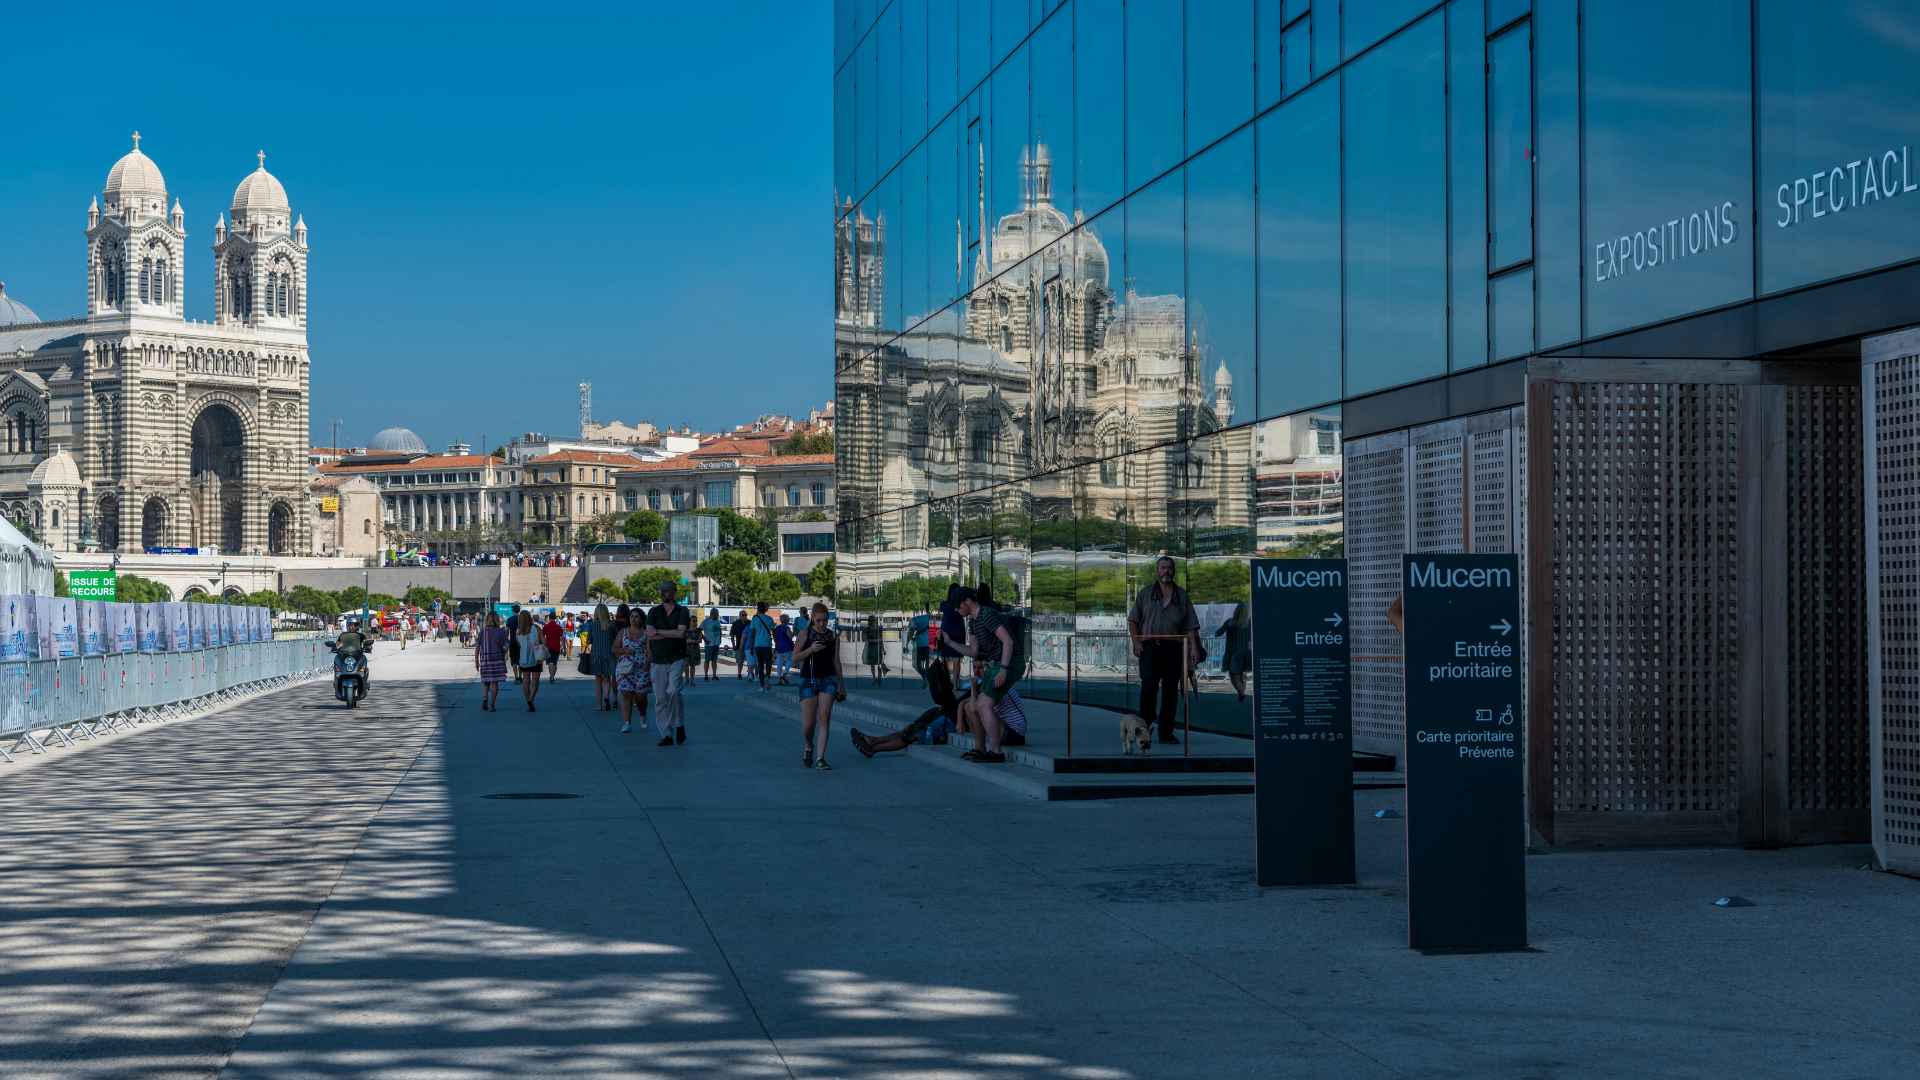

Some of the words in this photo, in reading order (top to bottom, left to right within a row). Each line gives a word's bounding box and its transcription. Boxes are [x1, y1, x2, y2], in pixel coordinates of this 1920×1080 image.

[1776, 145, 1918, 228] SPECTACL
[1595, 201, 1736, 282] EXPOSITIONS
[71, 578, 98, 586] ISSUE
[103, 578, 115, 586] DE
[1257, 566, 1342, 587] Mucem
[1410, 562, 1511, 588] Mucem
[71, 587, 114, 596] SECOURS
[1295, 631, 1343, 645] Entrée
[1455, 641, 1512, 657] Entrée
[1430, 663, 1512, 681] prioritaire
[1416, 731, 1452, 743] Carte
[1455, 731, 1514, 745] prioritaire
[1459, 746, 1514, 759] Prévente
